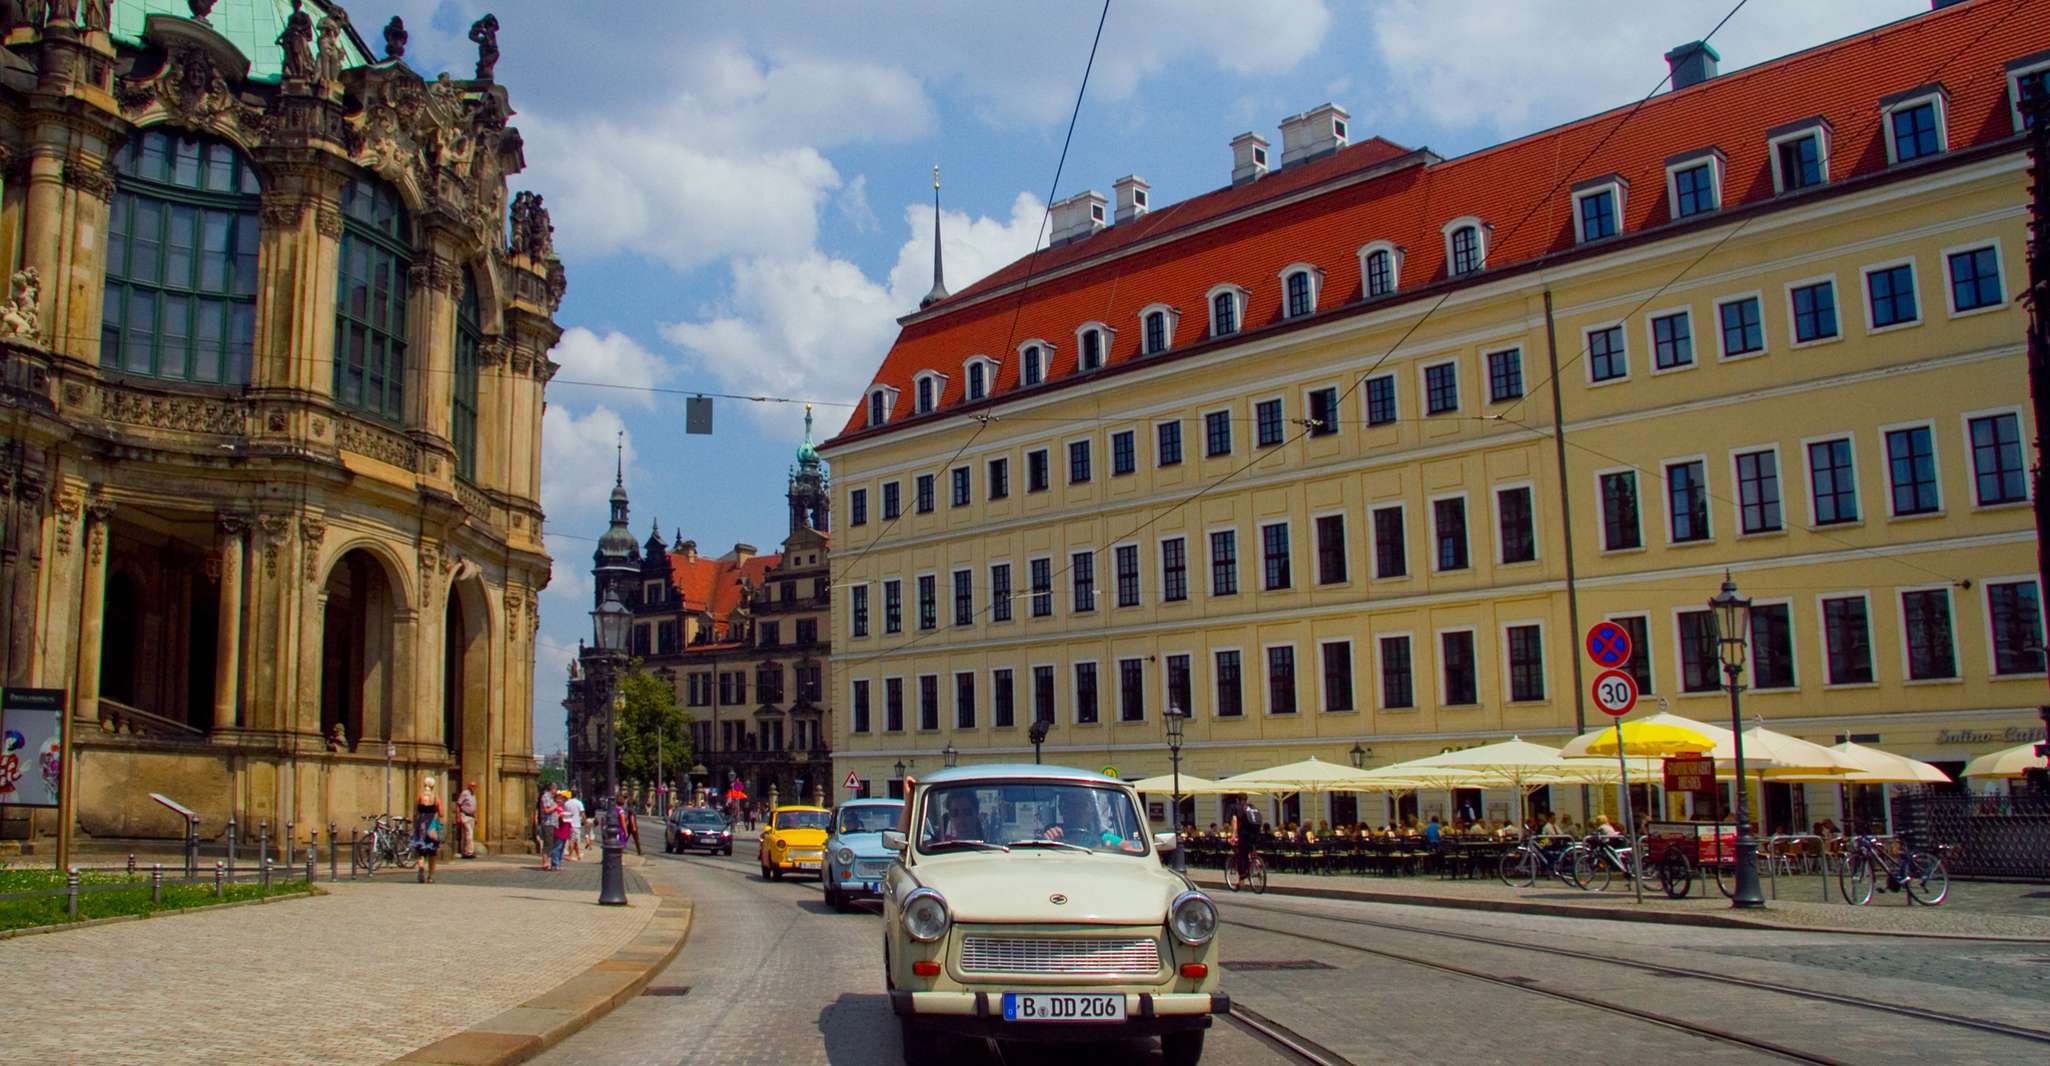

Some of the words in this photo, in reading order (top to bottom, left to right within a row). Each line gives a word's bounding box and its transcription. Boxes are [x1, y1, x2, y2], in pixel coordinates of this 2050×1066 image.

[1601, 683, 1629, 704] 30
[1023, 997, 1036, 1017] B
[1051, 997, 1076, 1017] DD
[1080, 997, 1116, 1017] 206
